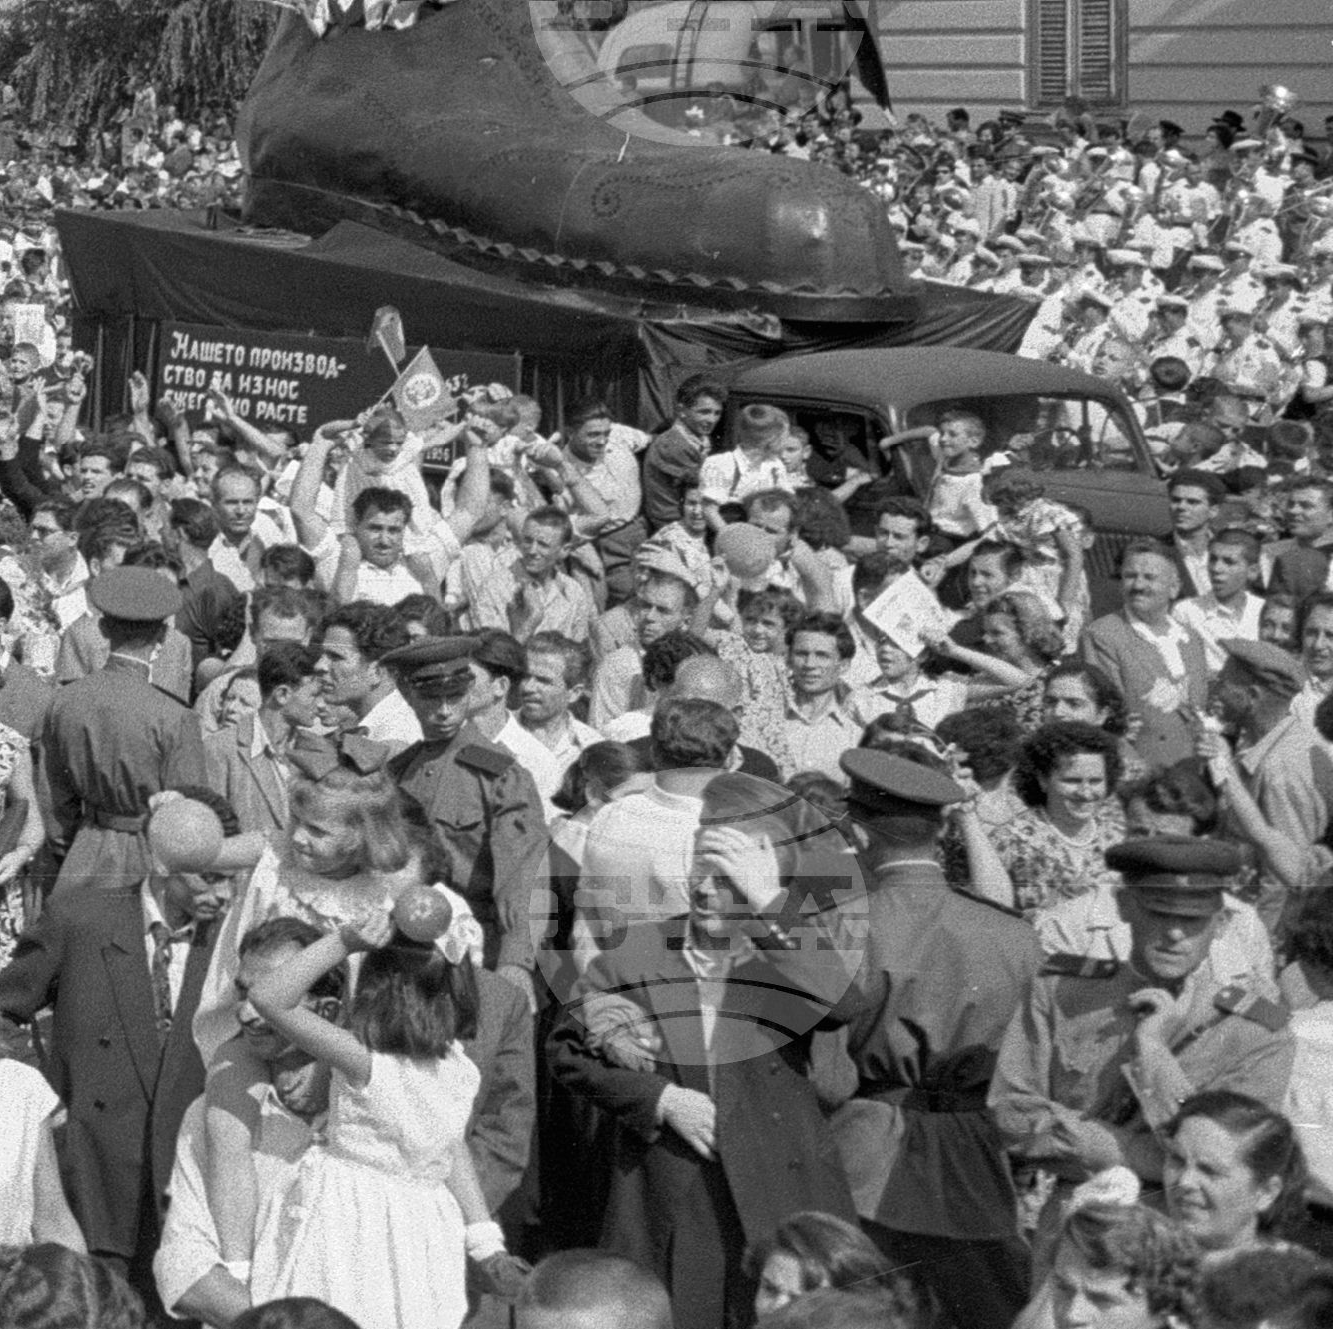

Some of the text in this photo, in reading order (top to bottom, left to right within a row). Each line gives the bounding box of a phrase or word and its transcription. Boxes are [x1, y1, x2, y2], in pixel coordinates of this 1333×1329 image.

[249, 346, 347, 379] ПРОИЗВОД-
[163, 364, 206, 388] СТВО
[239, 373, 300, 400] ИЗНОС
[163, 389, 309, 424] ЕЖЕГНО РАСТЕ
